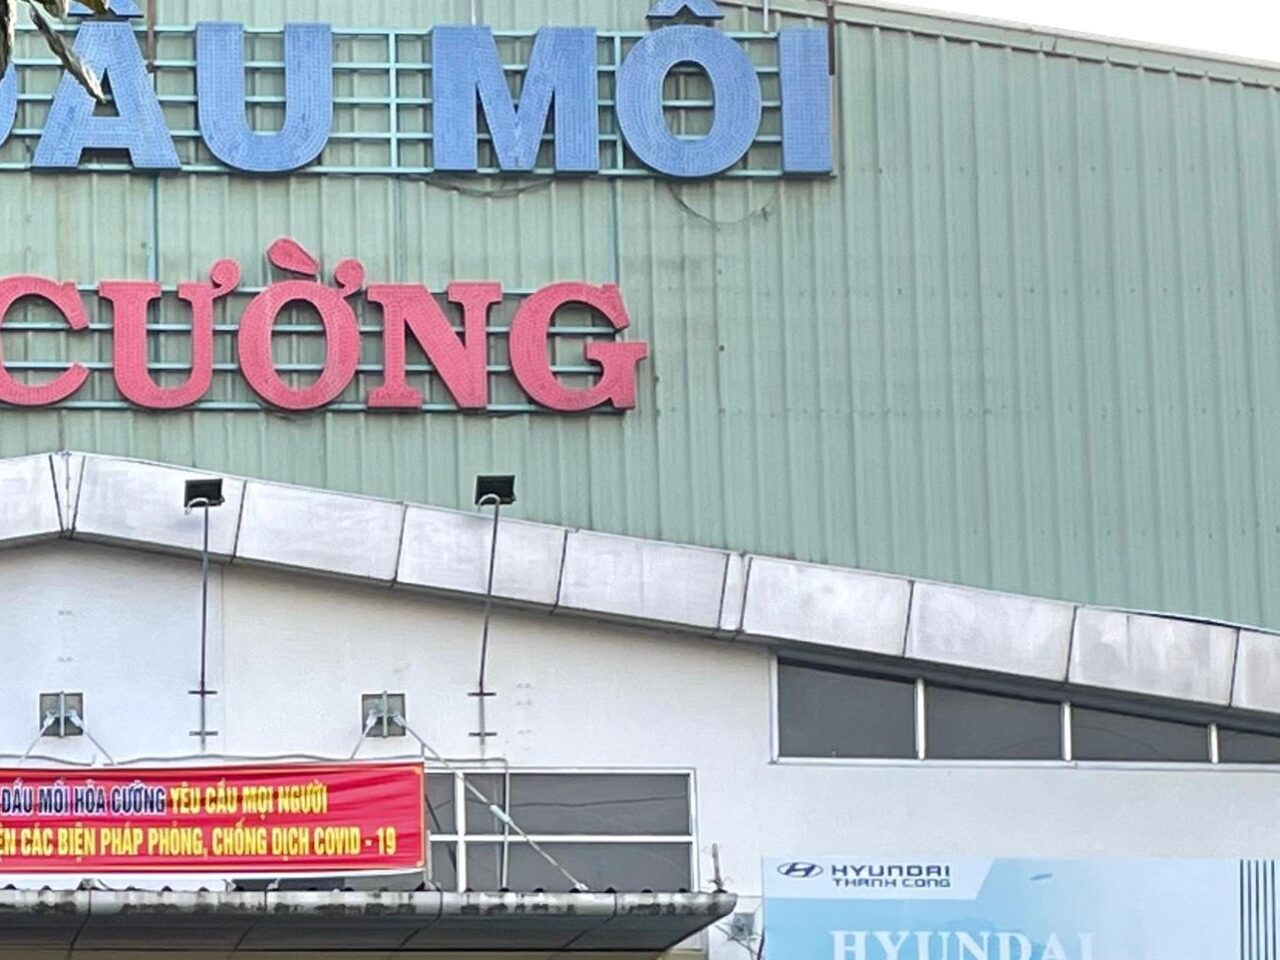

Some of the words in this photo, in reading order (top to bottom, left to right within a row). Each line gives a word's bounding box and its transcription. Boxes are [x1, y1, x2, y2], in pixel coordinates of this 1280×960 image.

[170, 783, 200, 814] YÊU
[205, 778, 238, 814] CẦU
[242, 785, 274, 820] MỌI
[278, 780, 328, 815] NGƯỜI
[20, 822, 53, 856] CÁC
[57, 822, 96, 863] BIỆN
[100, 821, 143, 856] PHÁP
[212, 817, 267, 856] CHỐNG
[272, 826, 309, 861] DỊCH
[314, 826, 361, 856] COVID
[376, 826, 396, 856] 19
[831, 865, 951, 877] HYUNDAI
[832, 878, 897, 888] THANH
[902, 878, 951, 888] CONG
